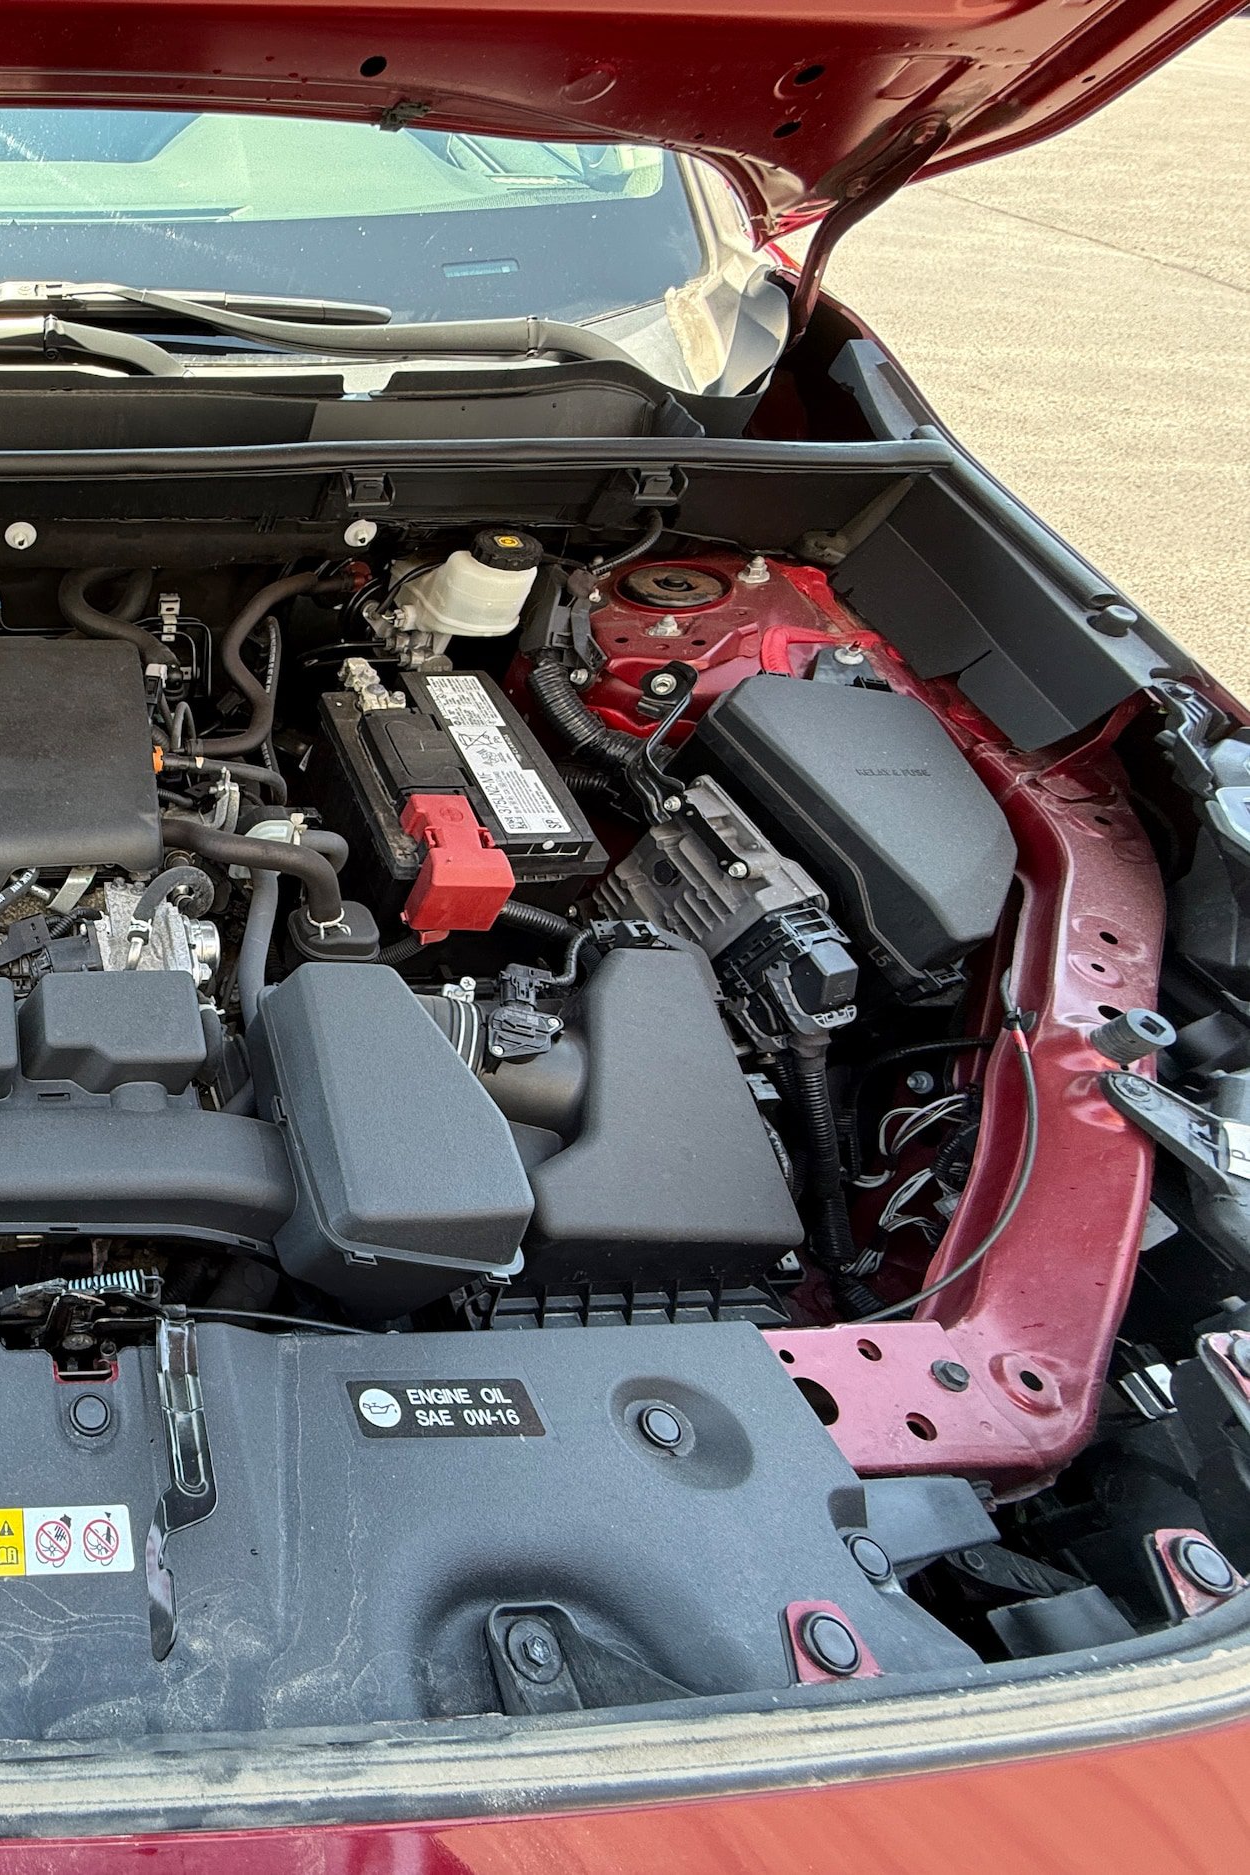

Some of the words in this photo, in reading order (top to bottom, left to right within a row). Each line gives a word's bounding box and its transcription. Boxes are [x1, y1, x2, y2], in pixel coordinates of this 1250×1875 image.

[868, 945, 892, 968] L5
[405, 1388, 473, 1405] ENGINE
[480, 1387, 513, 1404] OIL
[415, 1409, 454, 1426] SAE
[463, 1408, 521, 1426] 0W-16
